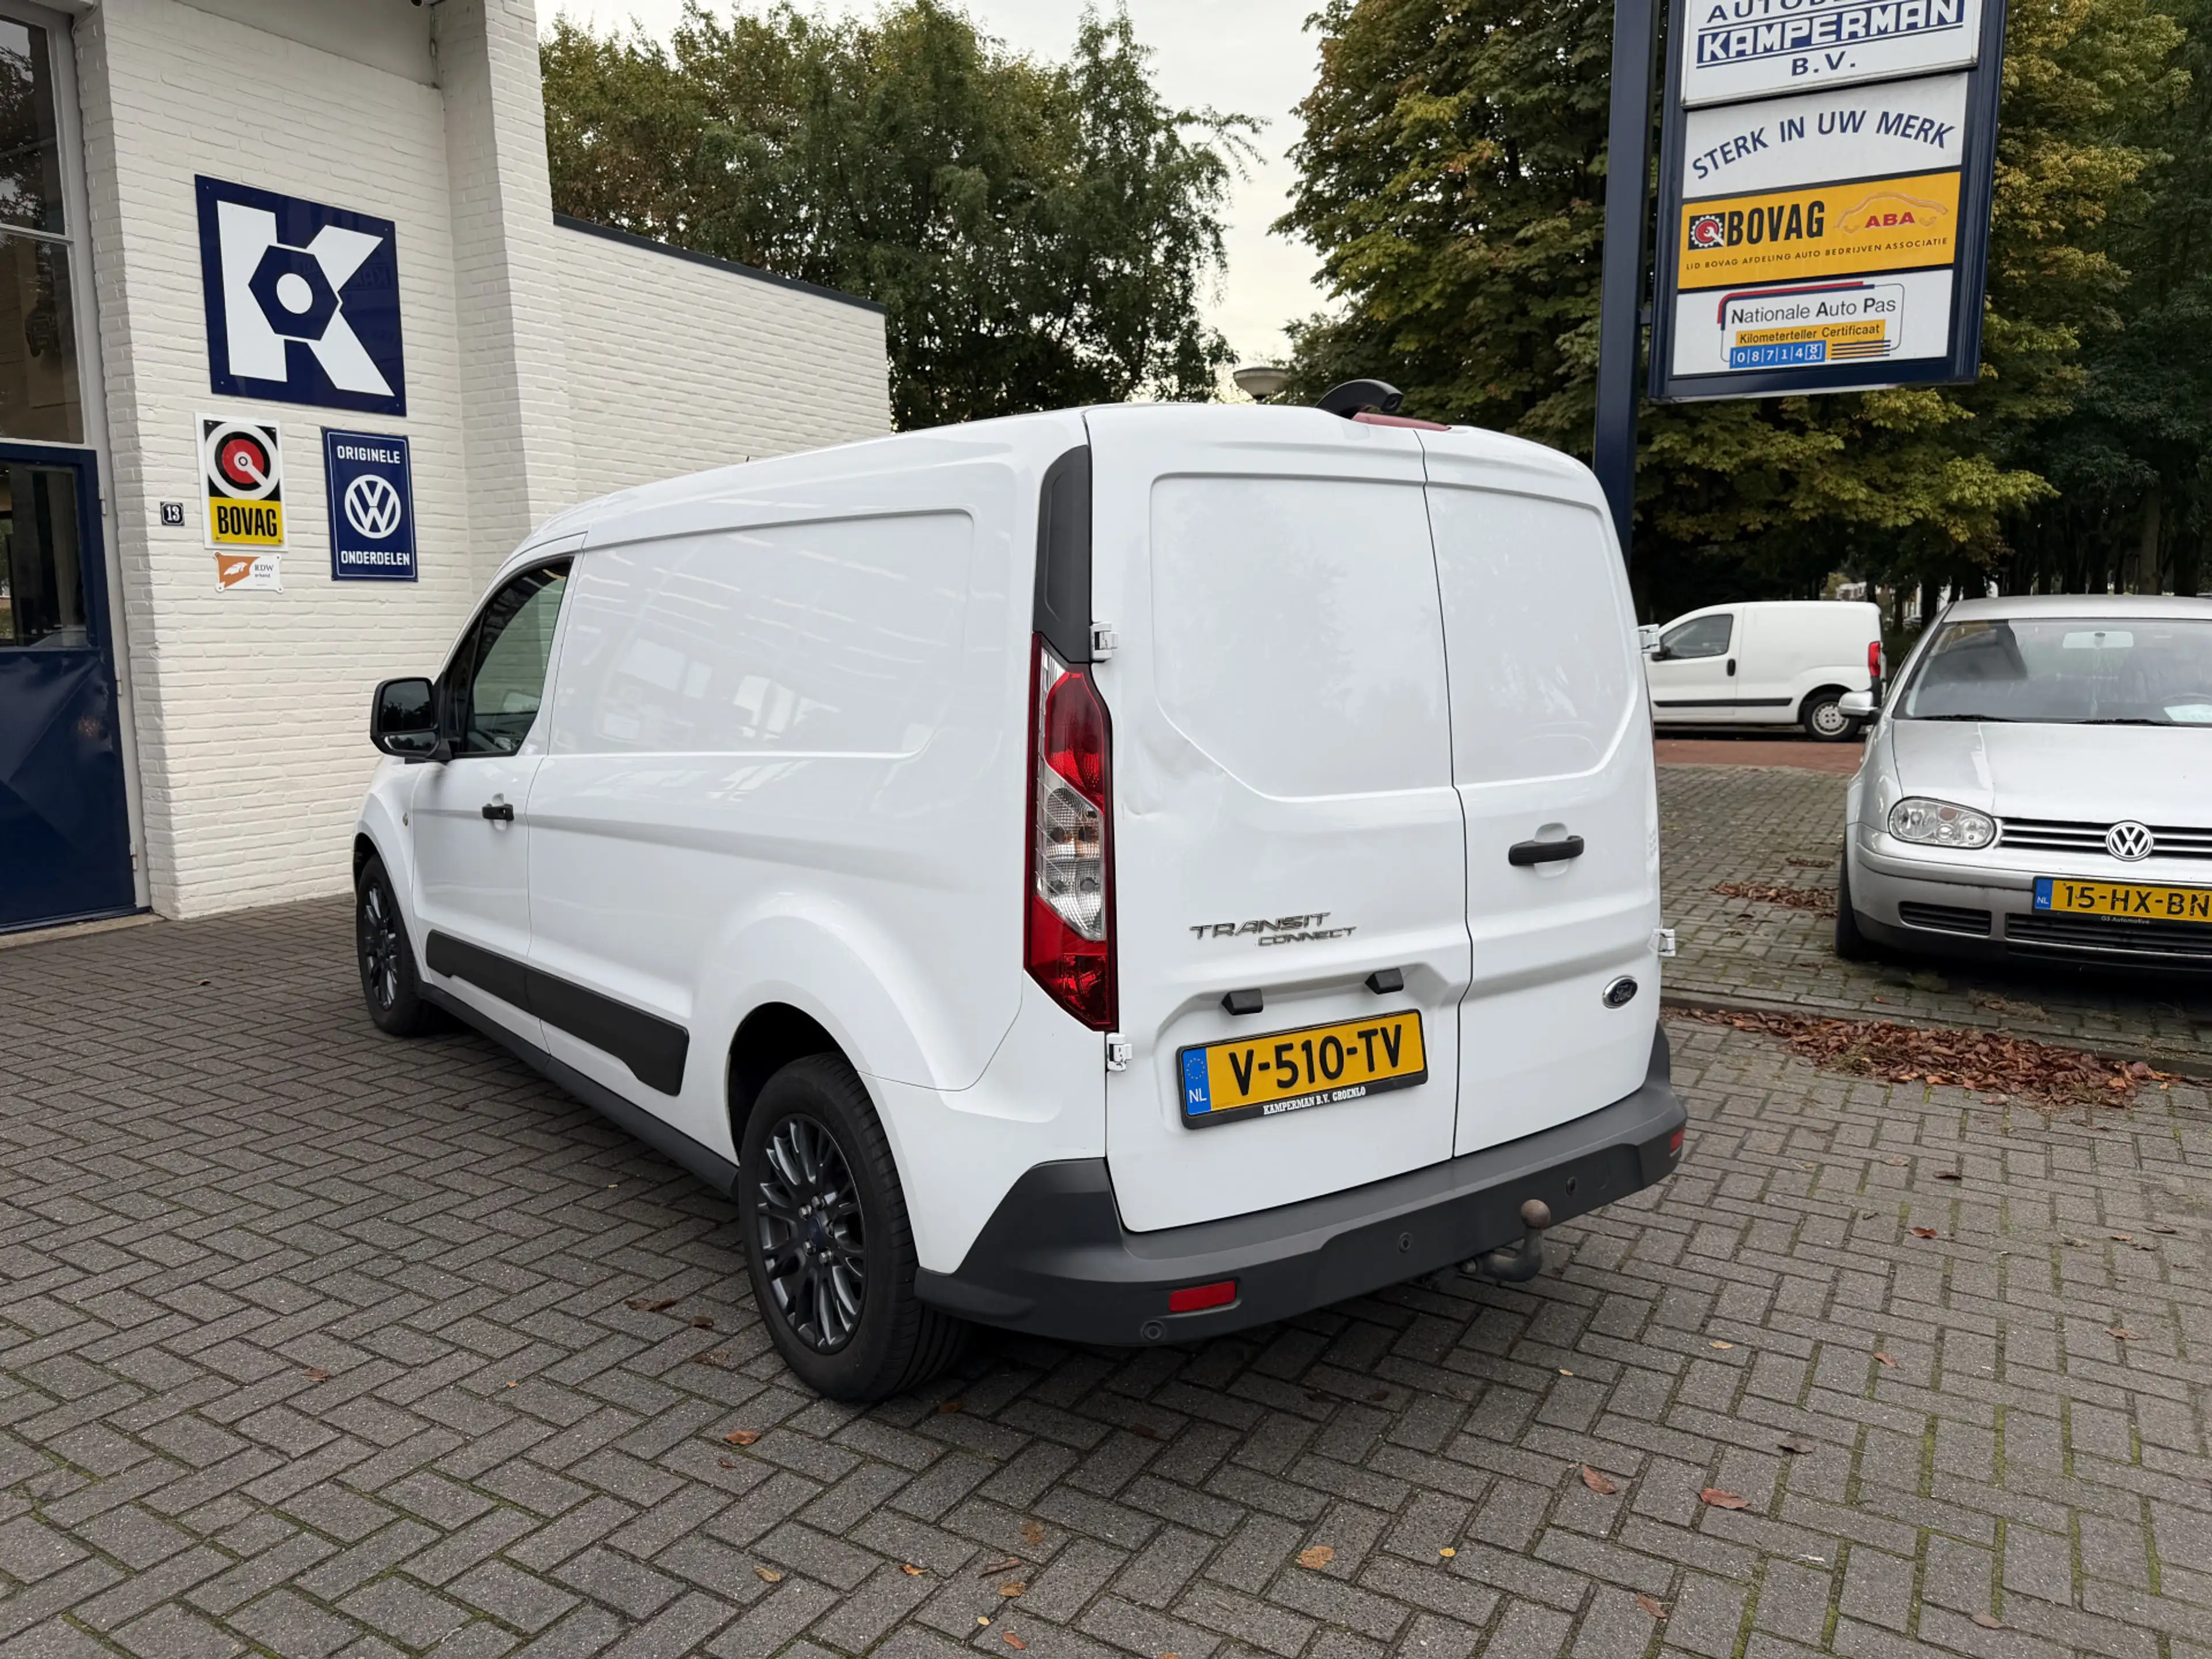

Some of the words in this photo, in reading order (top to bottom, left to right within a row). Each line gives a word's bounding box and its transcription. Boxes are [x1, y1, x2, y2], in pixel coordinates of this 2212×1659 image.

[1702, 0, 1957, 62] KAMPERMAN
[1791, 51, 1856, 76] B.V.
[1692, 127, 1769, 179] STERK
[1779, 116, 1805, 143] IN
[1818, 110, 1867, 135] UW
[1875, 111, 1956, 149] MERK
[1727, 200, 1825, 247] BOVAG
[1865, 212, 1915, 229] ABA
[1686, 262, 1700, 270] LID
[1705, 259, 1738, 268] BOVAG
[1742, 253, 1791, 265] AFDELING
[1795, 250, 1820, 259] AUTO
[1825, 244, 1882, 256] BEDRIJVEN
[1885, 237, 1948, 250] ASSOCIATIE
[1731, 304, 1810, 324] Nationale
[1816, 301, 1857, 317] Auto
[1863, 298, 1896, 313] Pas
[1740, 329, 1817, 344] Kilometerteller
[1822, 323, 1880, 338] Certificaat
[337, 445, 401, 464] ORIGINELE
[167, 505, 180, 521] 13
[217, 506, 278, 537] BOVAG
[341, 550, 410, 566] ONDERDELEN
[2063, 884, 2210, 917] 15-HX-BN
[1189, 911, 1331, 940] TRANSIT
[1257, 926, 1357, 946] CONNECT
[1229, 1024, 1402, 1096] V-510-TV
[1189, 1087, 1207, 1104] NL
[1263, 1096, 1315, 1115] KAMPERMAN
[1316, 1093, 1331, 1105] B.V.
